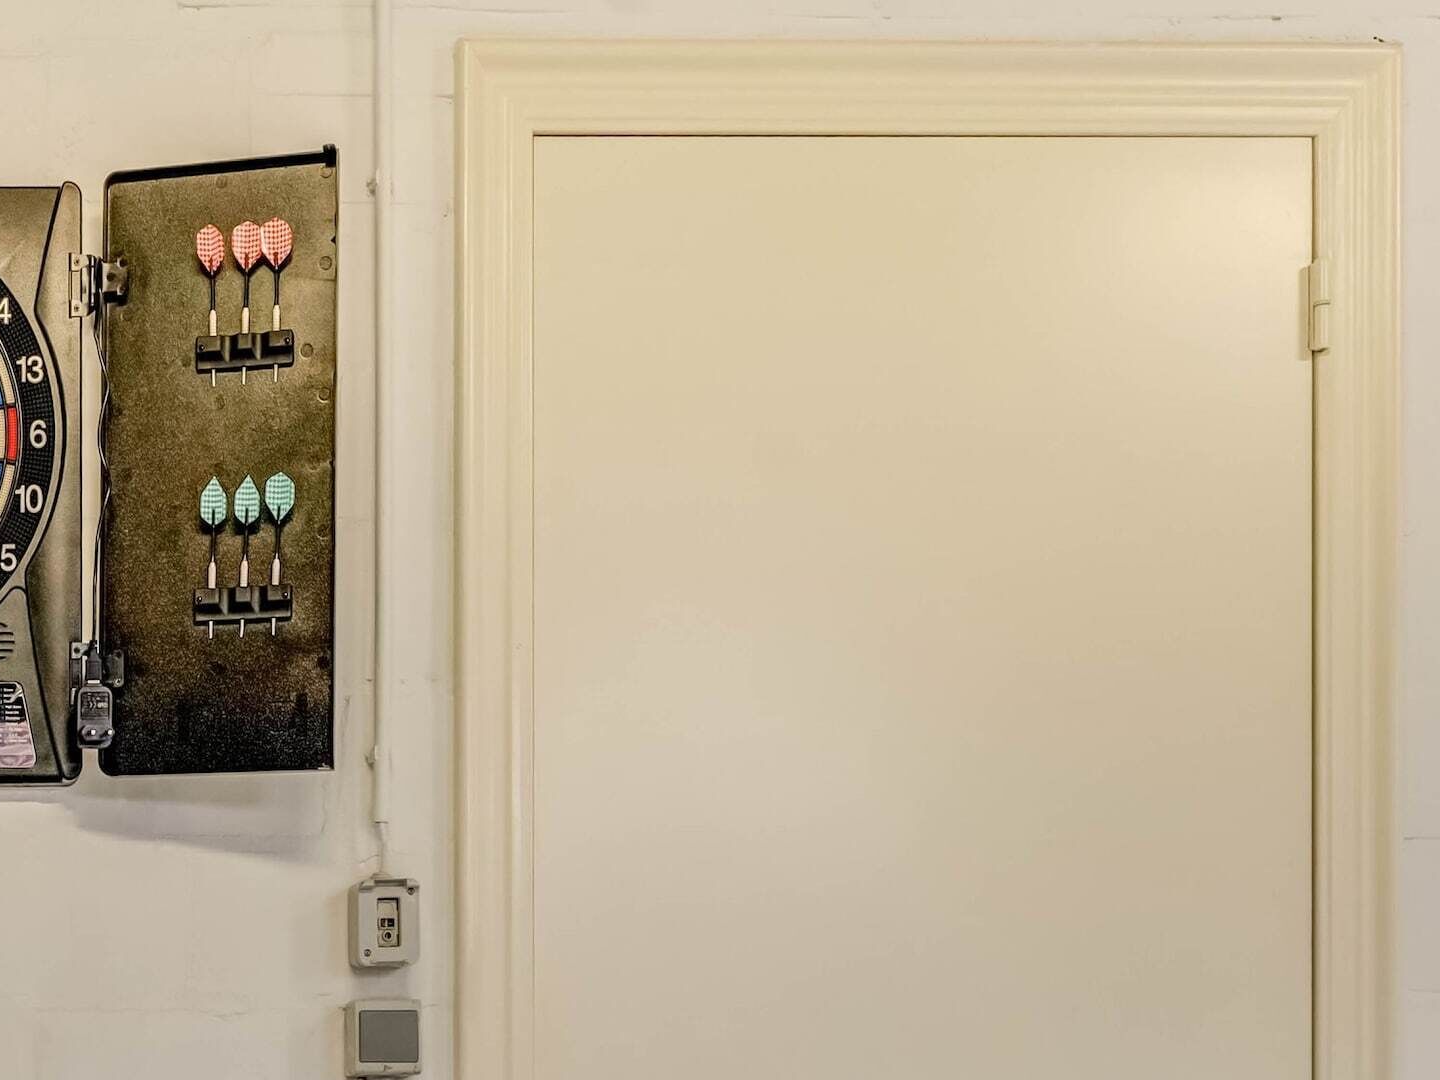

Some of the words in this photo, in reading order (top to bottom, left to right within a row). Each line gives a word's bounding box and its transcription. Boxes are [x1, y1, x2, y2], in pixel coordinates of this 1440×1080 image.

[17, 356, 44, 382] 13
[30, 420, 47, 448] 6
[16, 485, 43, 513] 10
